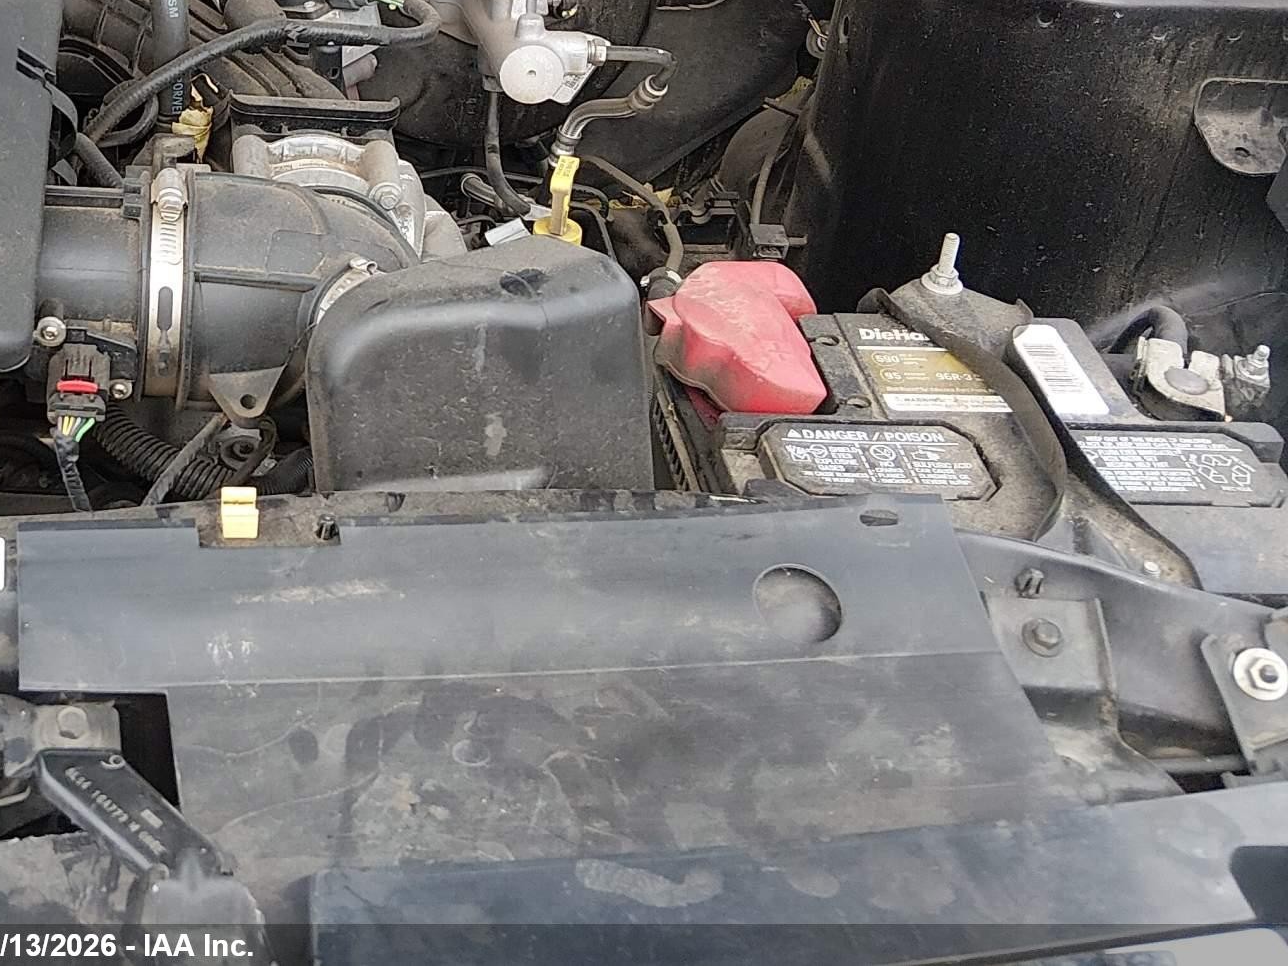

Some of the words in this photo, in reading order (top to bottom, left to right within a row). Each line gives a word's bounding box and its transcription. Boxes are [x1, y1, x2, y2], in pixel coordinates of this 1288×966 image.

[859, 328, 931, 341] DieHa
[801, 429, 868, 441] DANGER
[884, 432, 944, 442] POISON
